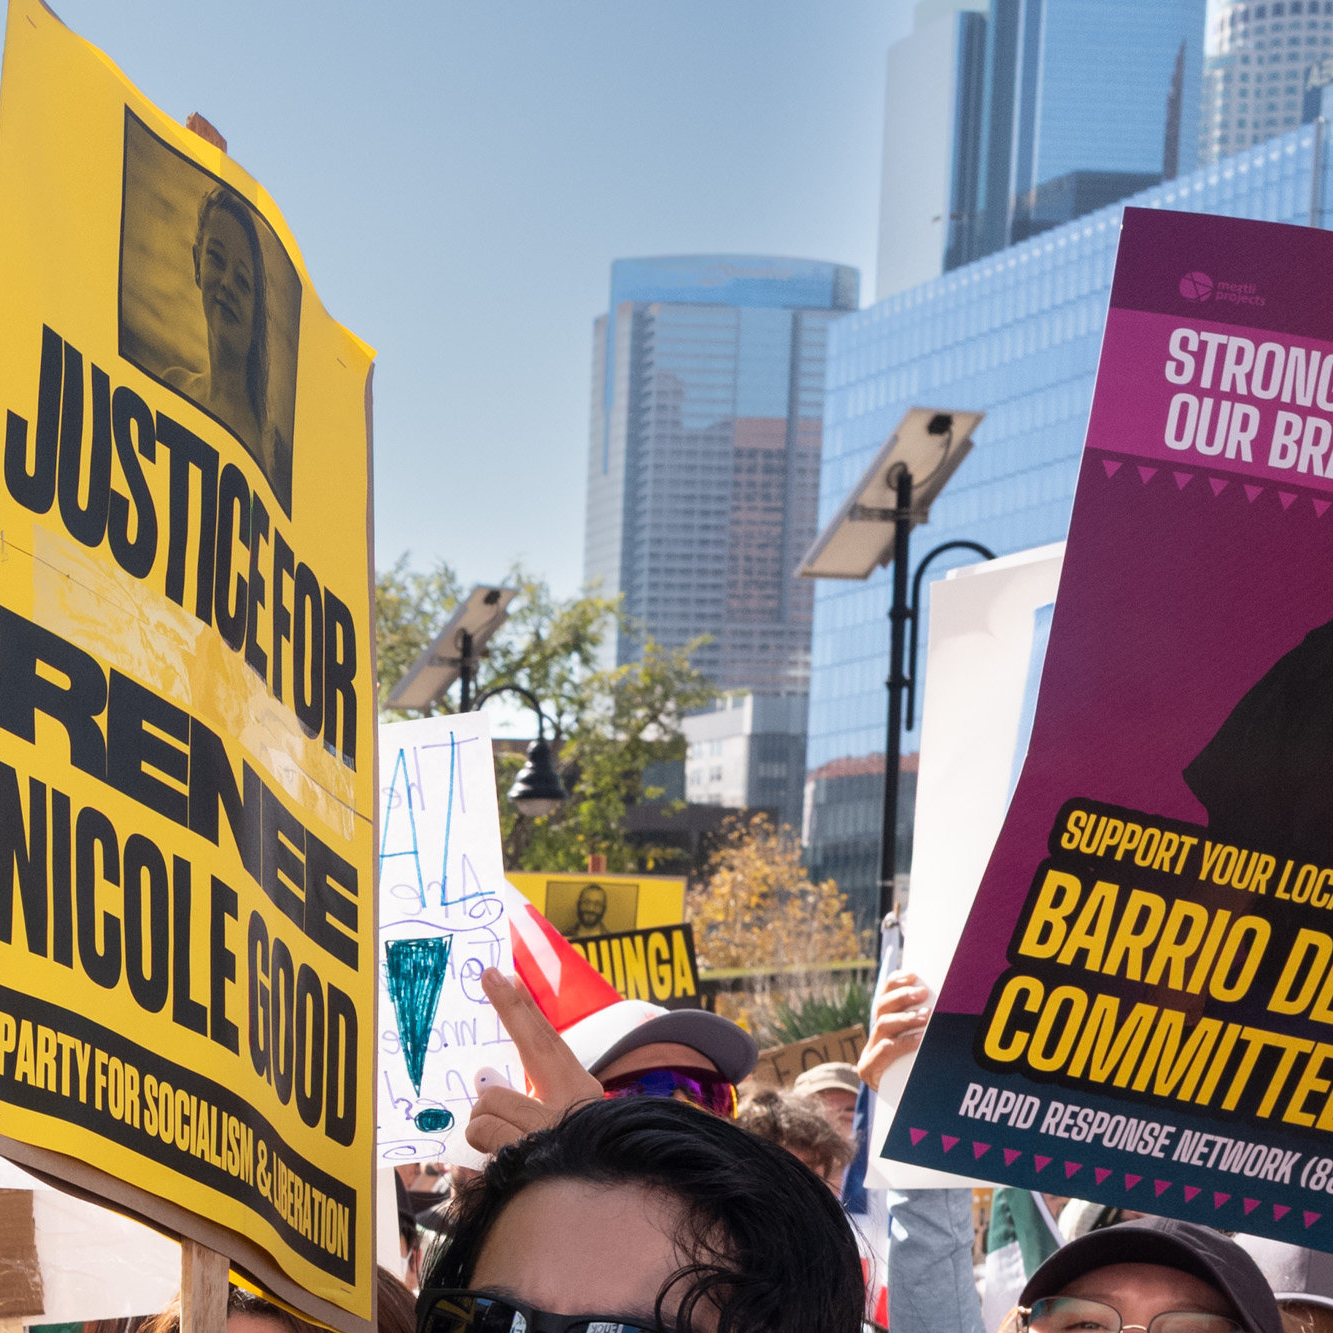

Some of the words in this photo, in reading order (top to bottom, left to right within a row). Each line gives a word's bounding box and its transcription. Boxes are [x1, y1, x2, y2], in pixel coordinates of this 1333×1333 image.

[1214, 290, 1266, 307] projects
[1164, 392, 1261, 463] OUR
[4, 323, 270, 672] JUSTICE
[272, 526, 358, 770] FOR
[1060, 809, 1199, 876] SUPPORT
[1199, 840, 1277, 895] YOUR
[1275, 858, 1333, 910] LOC
[1018, 868, 1273, 1004] BARRIO
[247, 908, 358, 1148] GOOD
[94, 1052, 141, 1123] FOR
[141, 1074, 255, 1188] SOCIALISM
[256, 1140, 274, 1201] &
[274, 1173, 350, 1262] LIBERATION
[958, 1082, 1041, 1130] RAPID
[1039, 1100, 1177, 1159] RESPONSE
[1172, 1129, 1303, 1185] NETWORK
